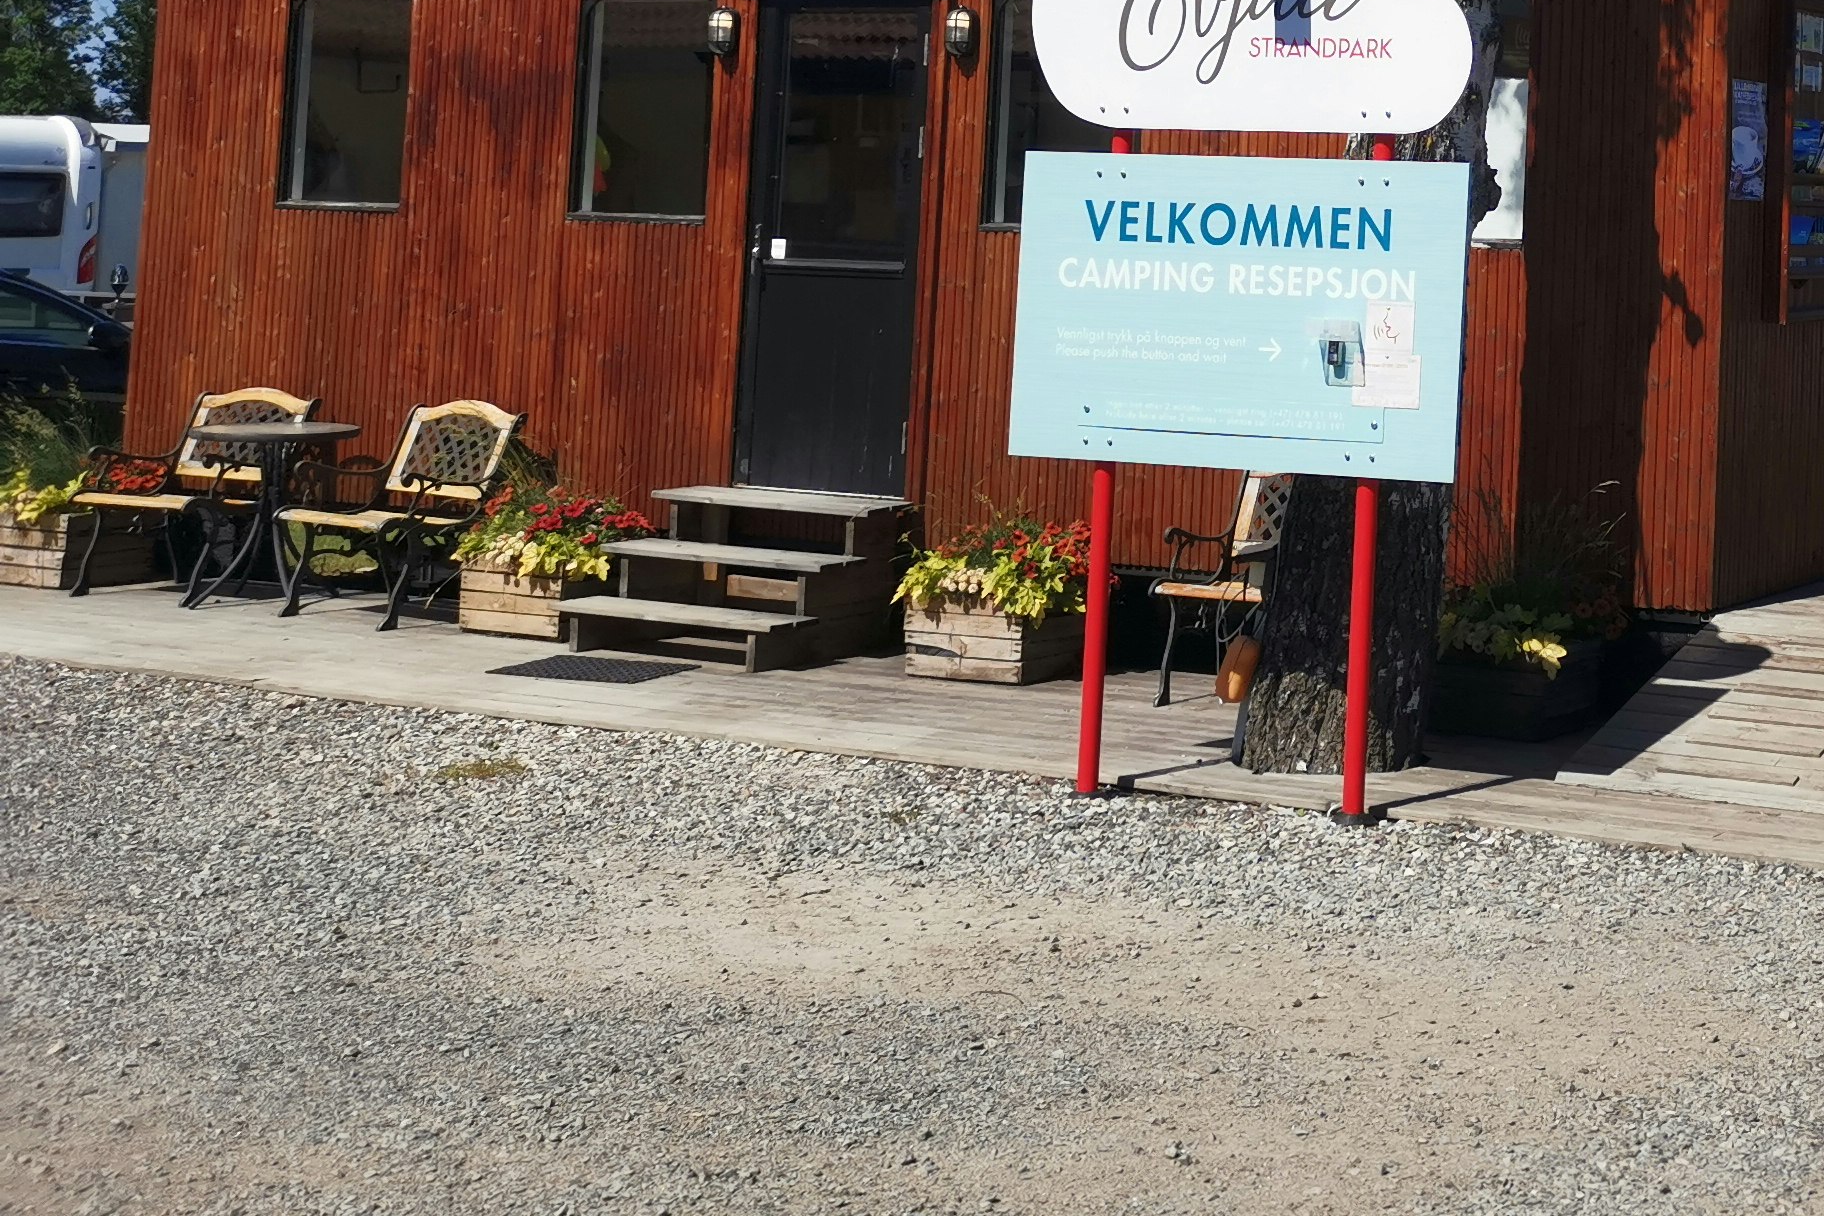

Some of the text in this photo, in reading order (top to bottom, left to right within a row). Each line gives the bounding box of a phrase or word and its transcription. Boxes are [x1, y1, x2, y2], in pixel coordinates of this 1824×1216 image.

[1248, 37, 1393, 59] STRANDPARK
[1085, 199, 1392, 251] VELKOMMEN
[1058, 256, 1415, 302] CAMPING RESEPSJON
[1056, 326, 1247, 350] Vennligst trykk på knappen og vent
[1055, 343, 1227, 364] Please push the button and wait
